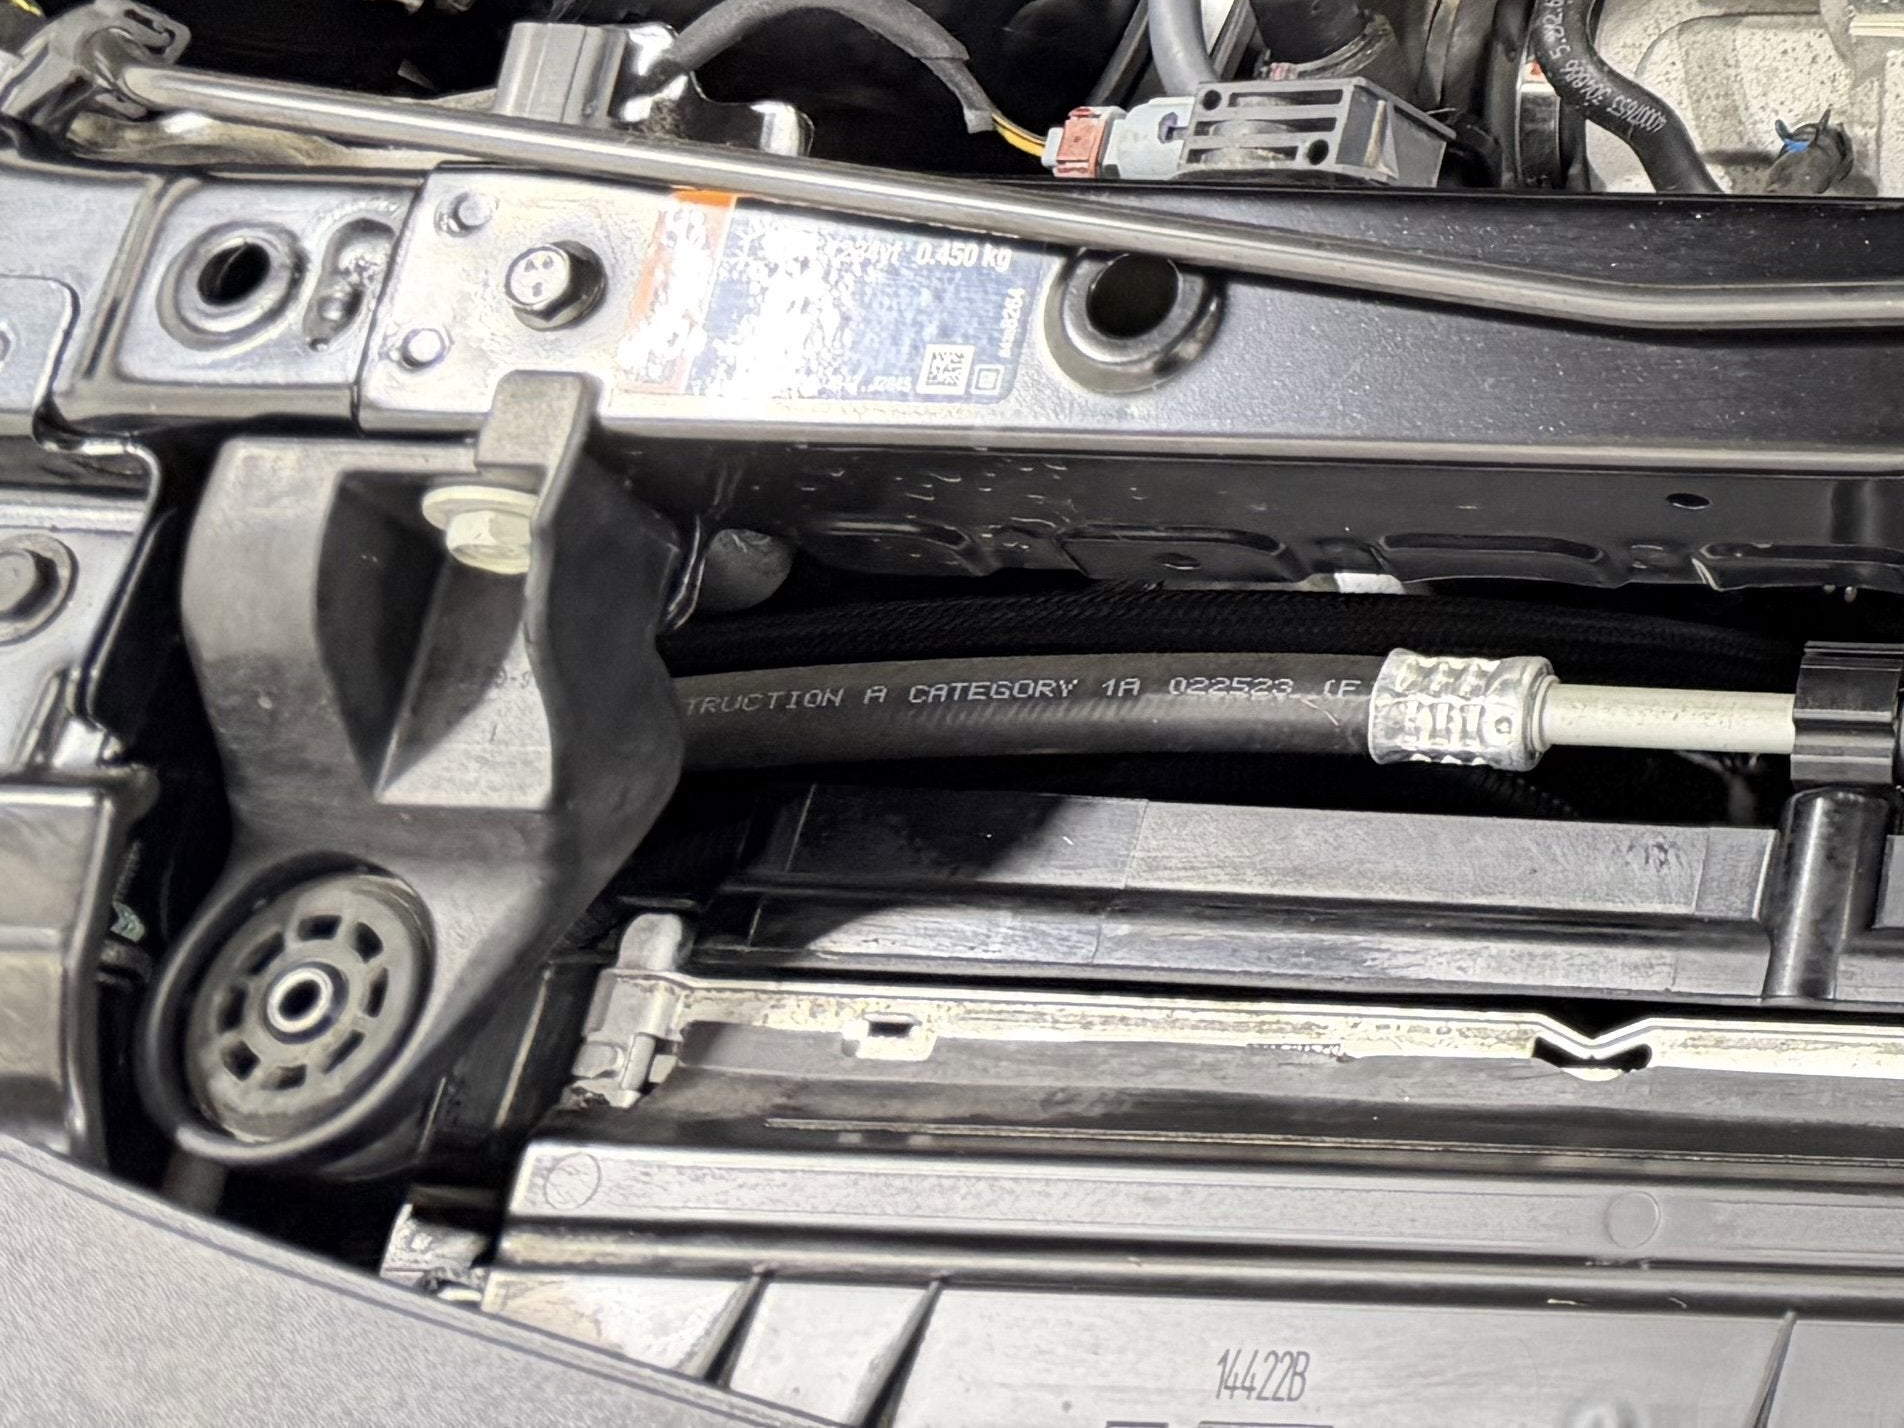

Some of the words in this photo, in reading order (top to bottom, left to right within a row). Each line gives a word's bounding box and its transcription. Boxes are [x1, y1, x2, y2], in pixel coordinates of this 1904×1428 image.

[916, 242, 978, 267] 0.450
[982, 244, 1013, 273] kg
[685, 688, 842, 715] TRUCTION
[864, 686, 887, 705] A
[907, 679, 1078, 704] CATEGORY
[1101, 678, 1141, 698] 1A
[1168, 677, 1294, 698] 022523
[1215, 1348, 1311, 1402] 14422B
